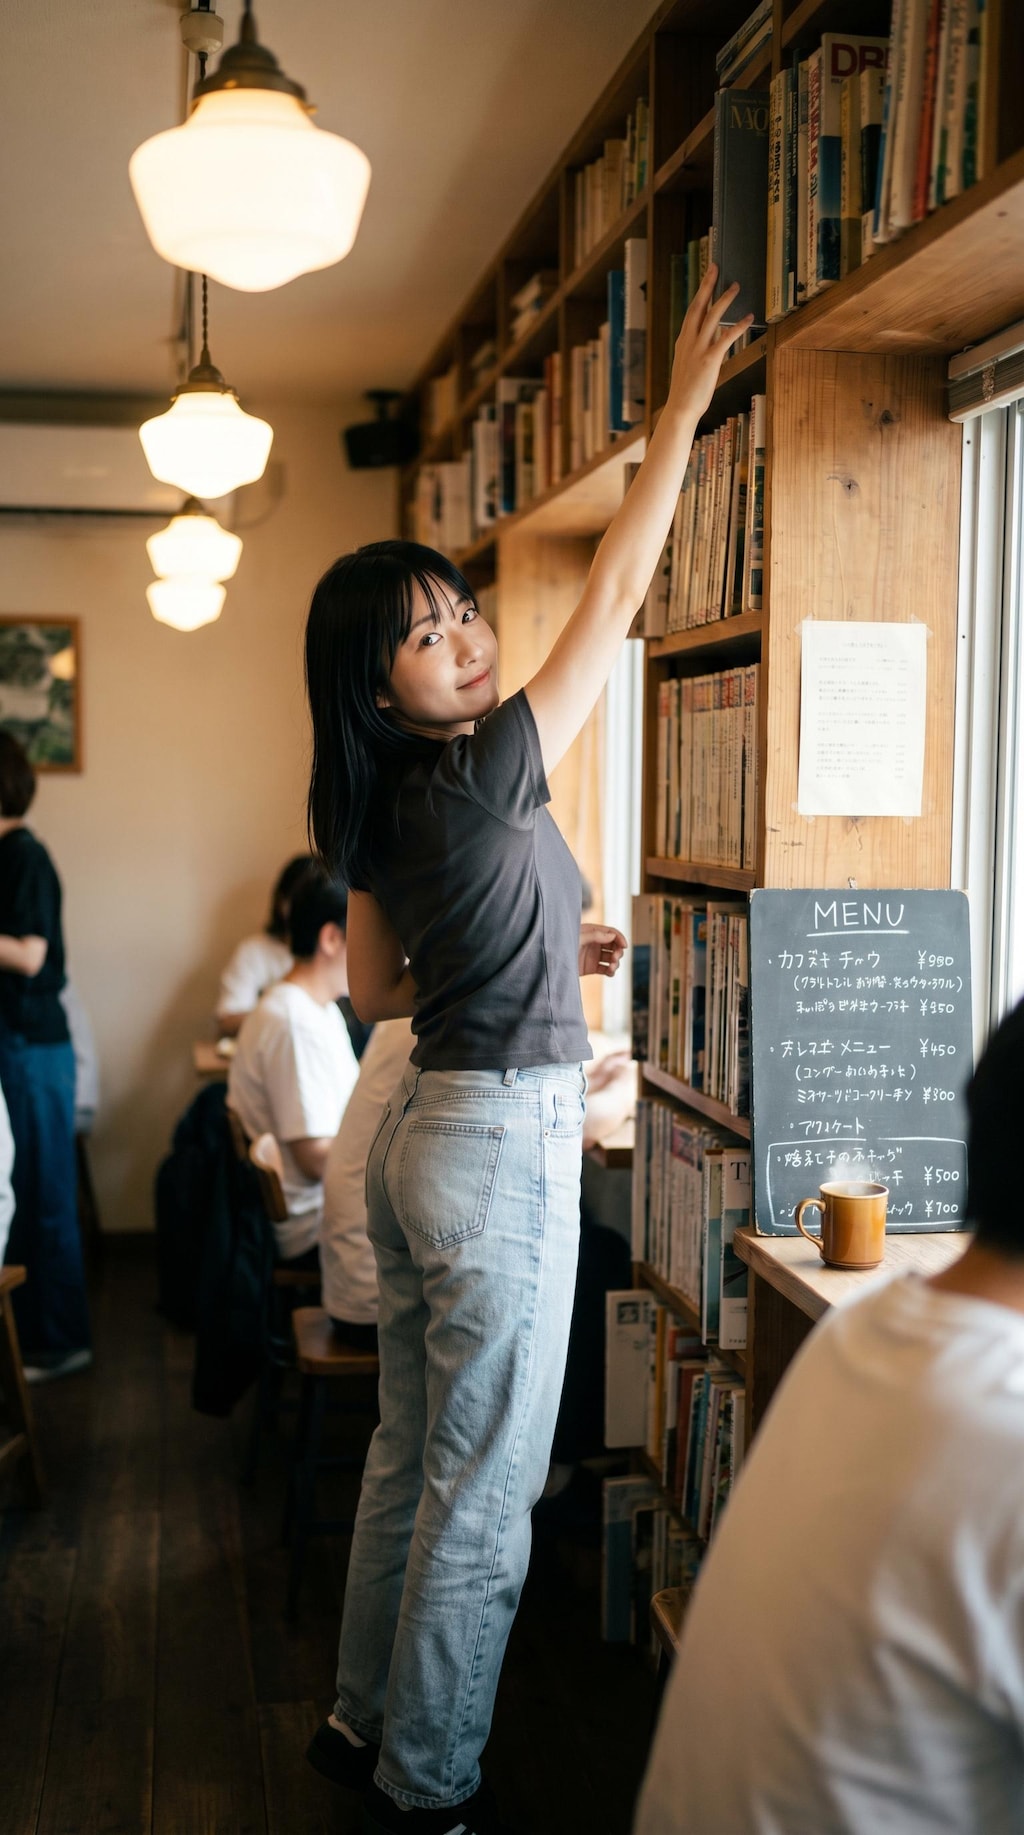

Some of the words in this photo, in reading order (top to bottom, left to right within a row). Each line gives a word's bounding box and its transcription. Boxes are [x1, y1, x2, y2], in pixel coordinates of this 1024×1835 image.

[831, 43, 891, 77] DR
[814, 901, 905, 929] MENU
[840, 1039, 891, 1056] メニュー
[919, 1038, 956, 1058] ¥450
[924, 1165, 960, 1187] ¥500
[924, 1199, 959, 1218] ¥700
